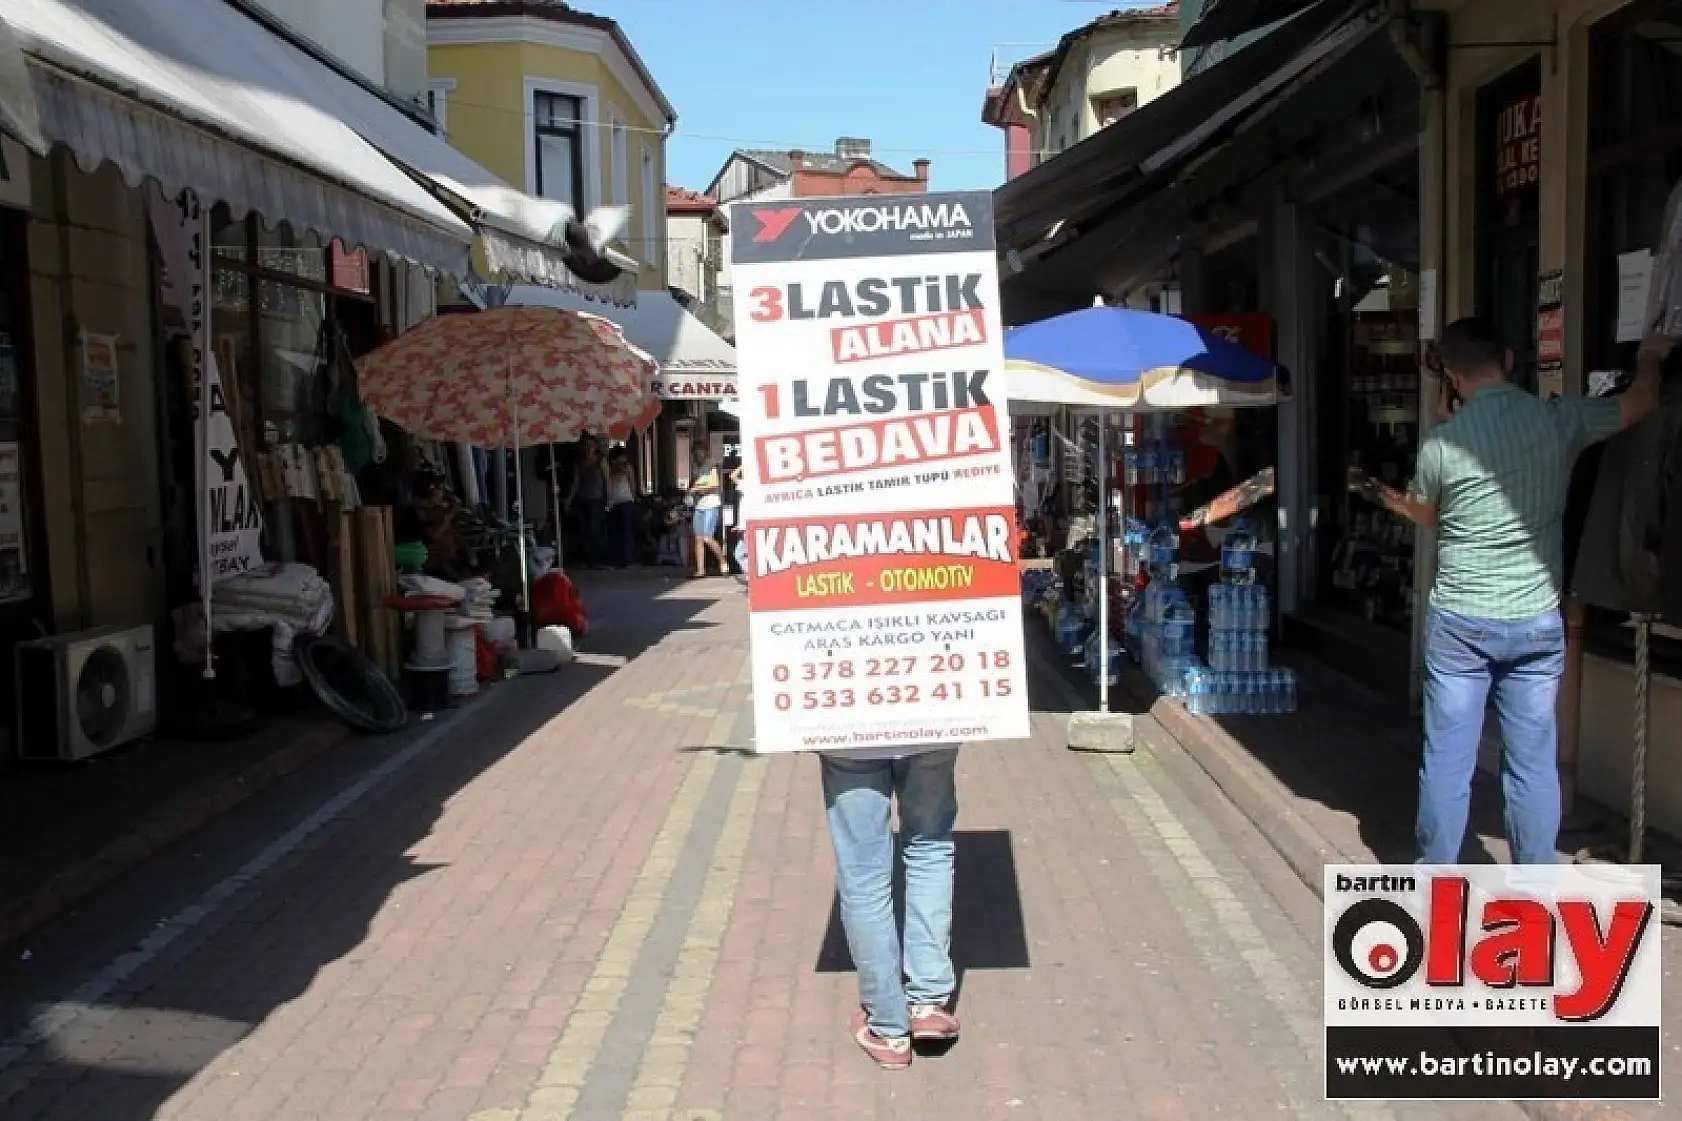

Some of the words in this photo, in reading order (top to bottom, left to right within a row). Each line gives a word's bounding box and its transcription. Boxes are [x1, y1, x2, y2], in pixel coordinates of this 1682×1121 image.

[803, 203, 972, 235] YOKOHAMA
[750, 285, 784, 322] 3
[838, 311, 983, 362] ALANA
[756, 384, 781, 420] 1
[763, 411, 994, 480] BEDAVA
[753, 513, 1013, 578] KARAMANLAR
[804, 636, 852, 651] ARAS
[859, 632, 925, 647] KARGO
[931, 628, 974, 643] YANI
[773, 664, 789, 682] 0
[802, 660, 855, 681] 378
[866, 655, 918, 677] 227
[930, 653, 965, 673] 20
[977, 649, 1011, 670] 18
[775, 692, 791, 711] 0
[802, 689, 856, 710] 533
[867, 685, 920, 706] 632
[931, 681, 963, 701] 41
[979, 678, 1012, 698] 15
[802, 725, 989, 746] www.bartinolay.com
